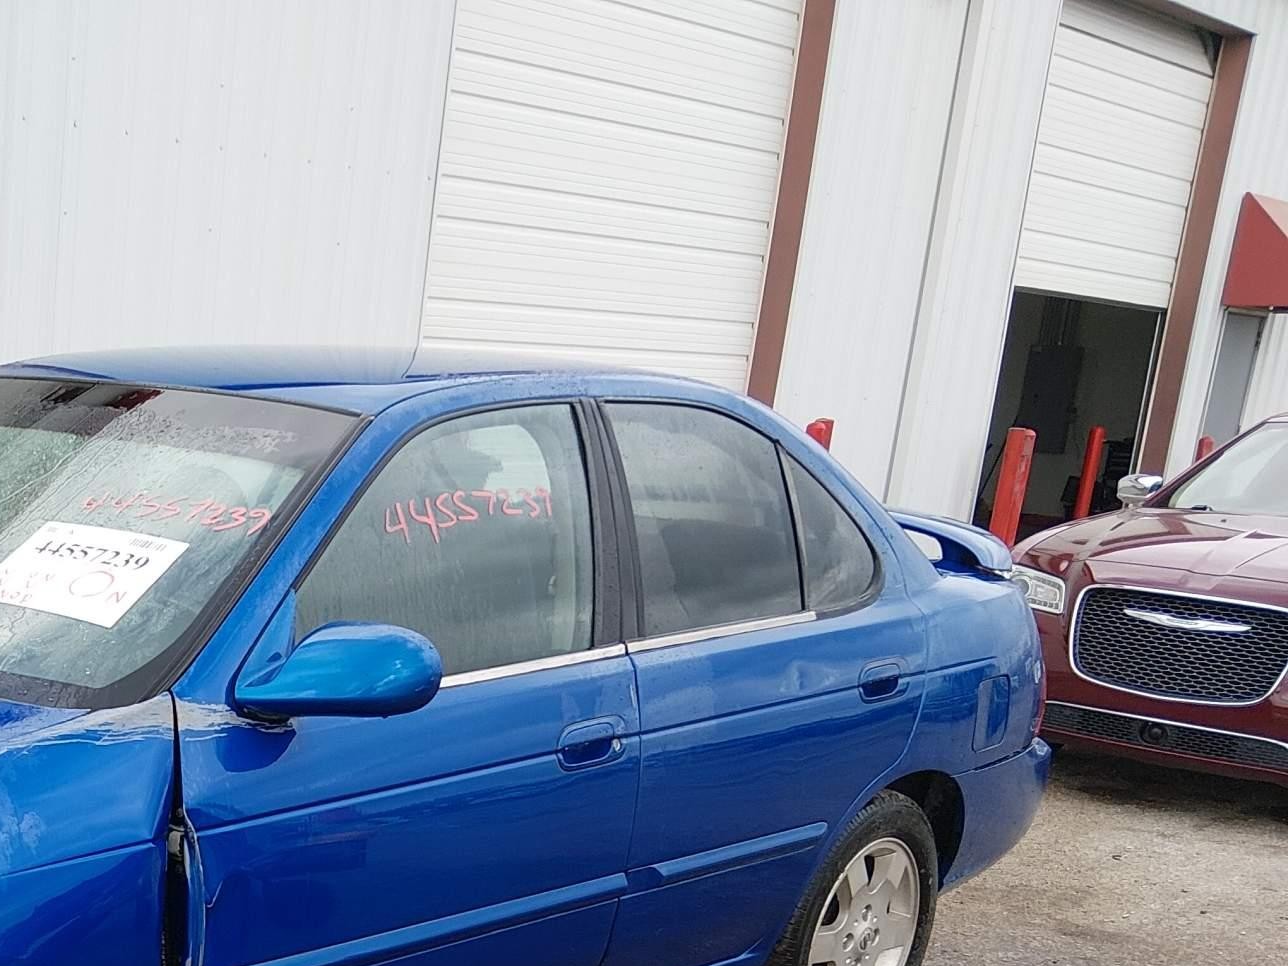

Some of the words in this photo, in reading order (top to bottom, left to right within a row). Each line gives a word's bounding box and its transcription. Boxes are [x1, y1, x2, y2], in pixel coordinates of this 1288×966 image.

[82, 491, 273, 537] 44557239
[385, 487, 552, 544] 44557239
[34, 540, 150, 570] 44557239
